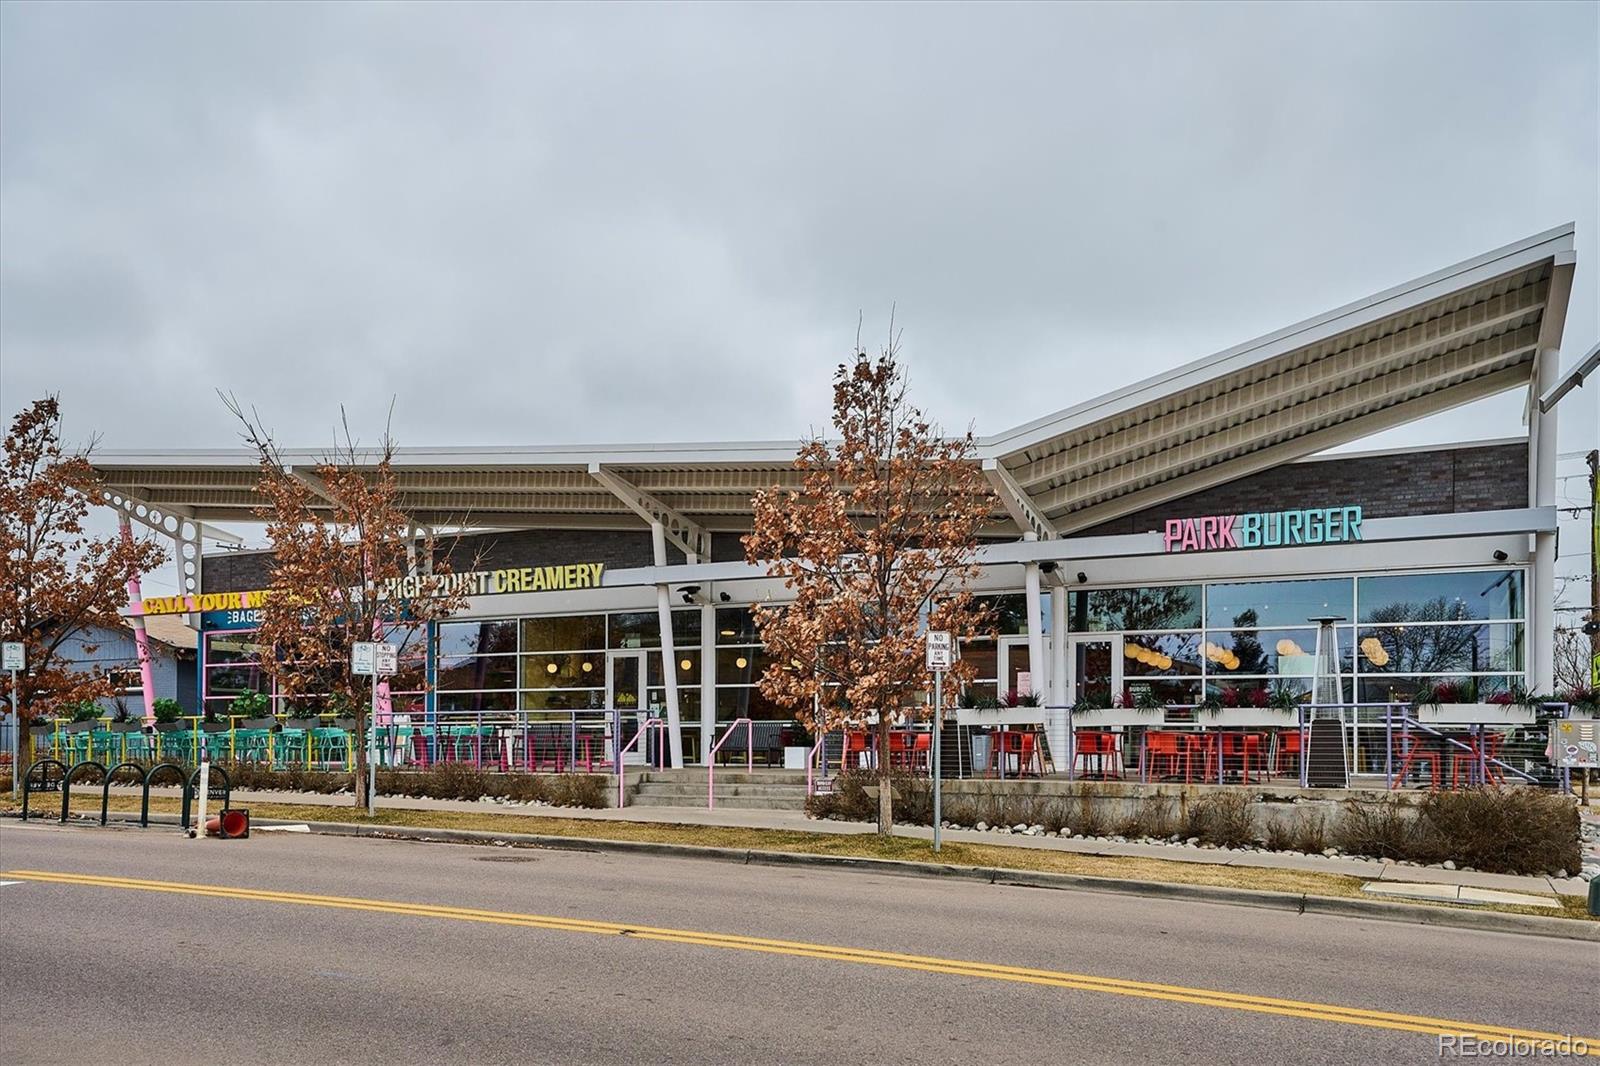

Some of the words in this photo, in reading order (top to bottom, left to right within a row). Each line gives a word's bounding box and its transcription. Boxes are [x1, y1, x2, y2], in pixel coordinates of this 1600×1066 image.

[1164, 515, 1237, 552] PARK
[1242, 505, 1362, 548] BURGER
[384, 575, 428, 599] HIGH
[493, 563, 604, 593] CREAMERY
[143, 597, 189, 614] CALL
[190, 593, 241, 612] YOUR
[934, 634, 943, 642] NO
